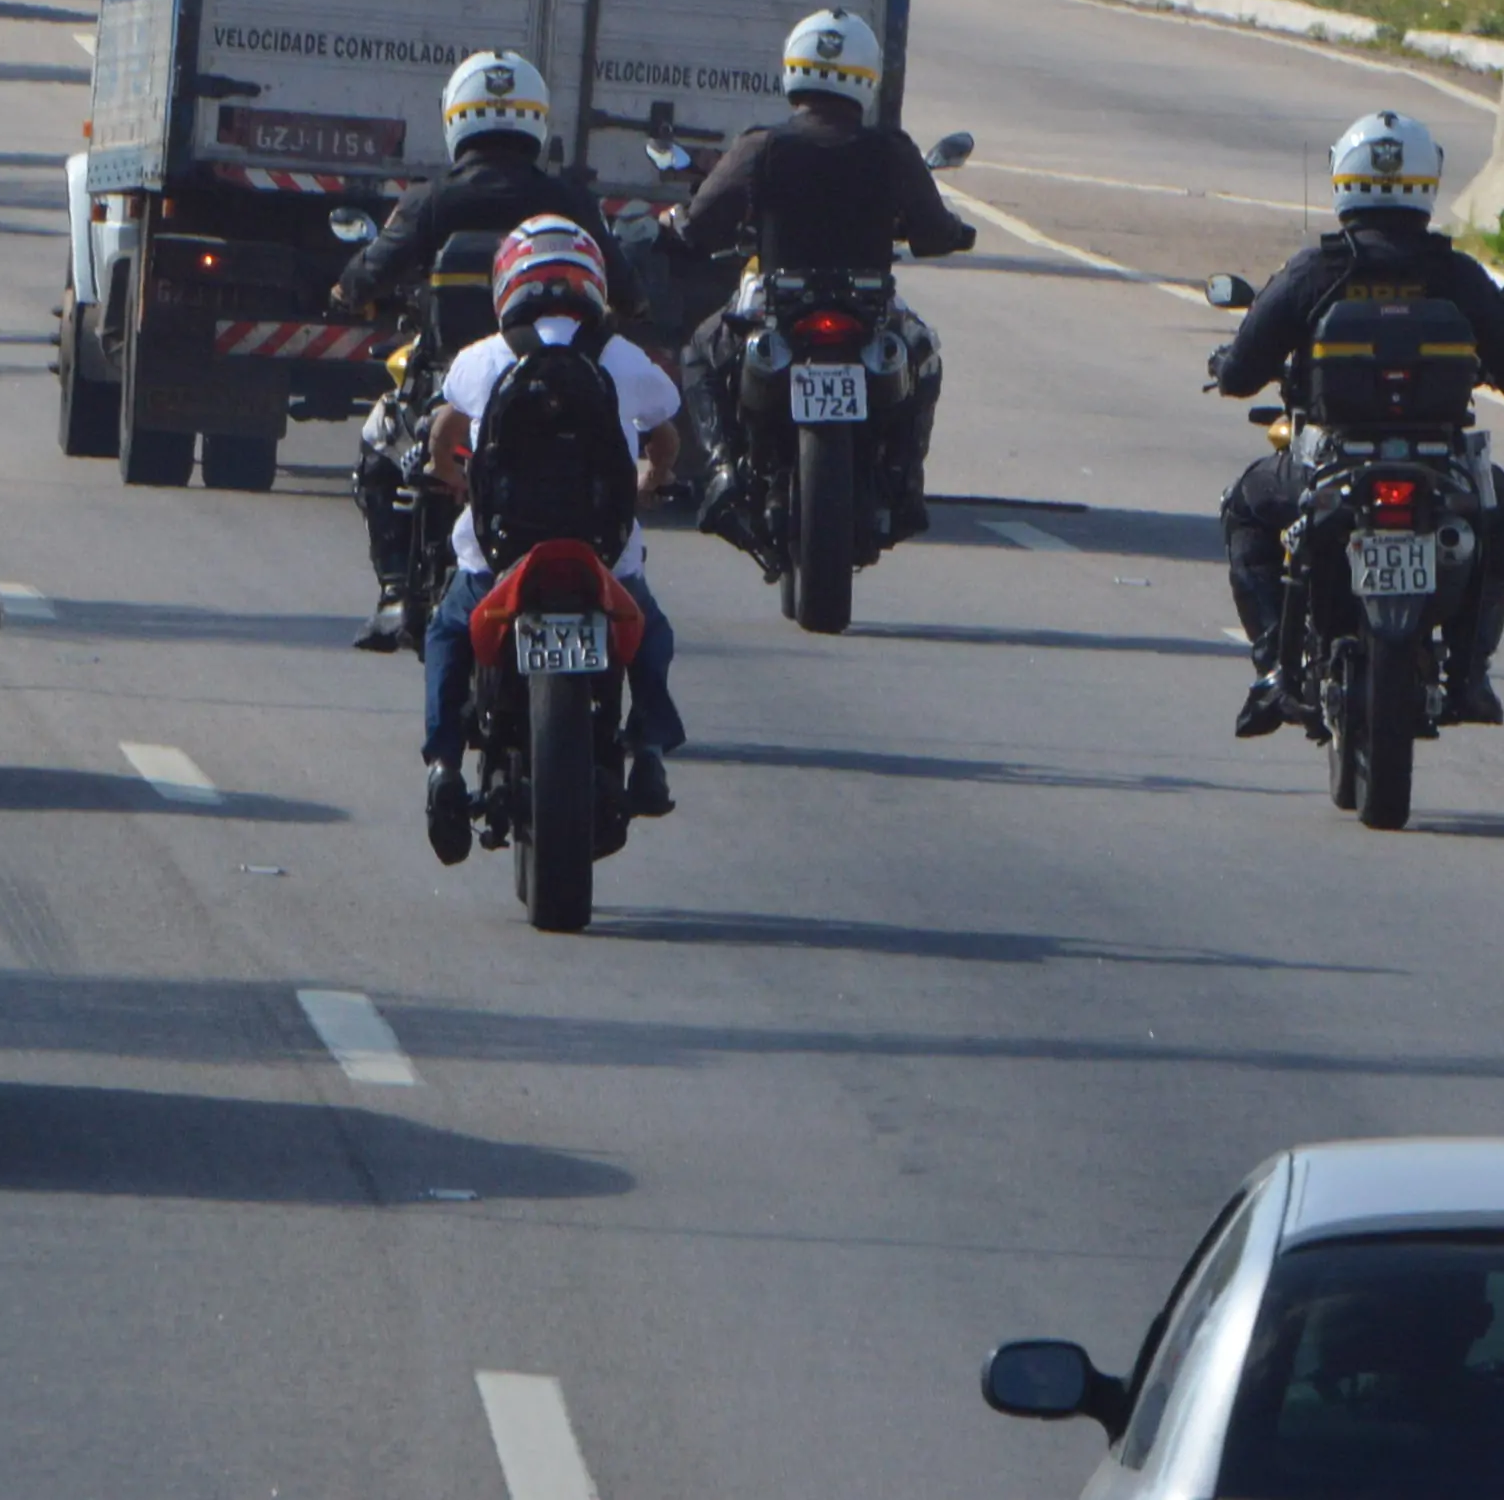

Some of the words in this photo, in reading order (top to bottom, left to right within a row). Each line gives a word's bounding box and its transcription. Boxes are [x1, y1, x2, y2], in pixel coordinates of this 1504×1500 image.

[213, 27, 328, 57] VELOCIDADE
[333, 36, 457, 66] CONTROLADA
[595, 60, 692, 89] VELOCIDADE
[696, 67, 786, 97] CONTROLA
[804, 397, 858, 418] 1724
[530, 627, 595, 648] MYH
[528, 648, 599, 671] 0915
